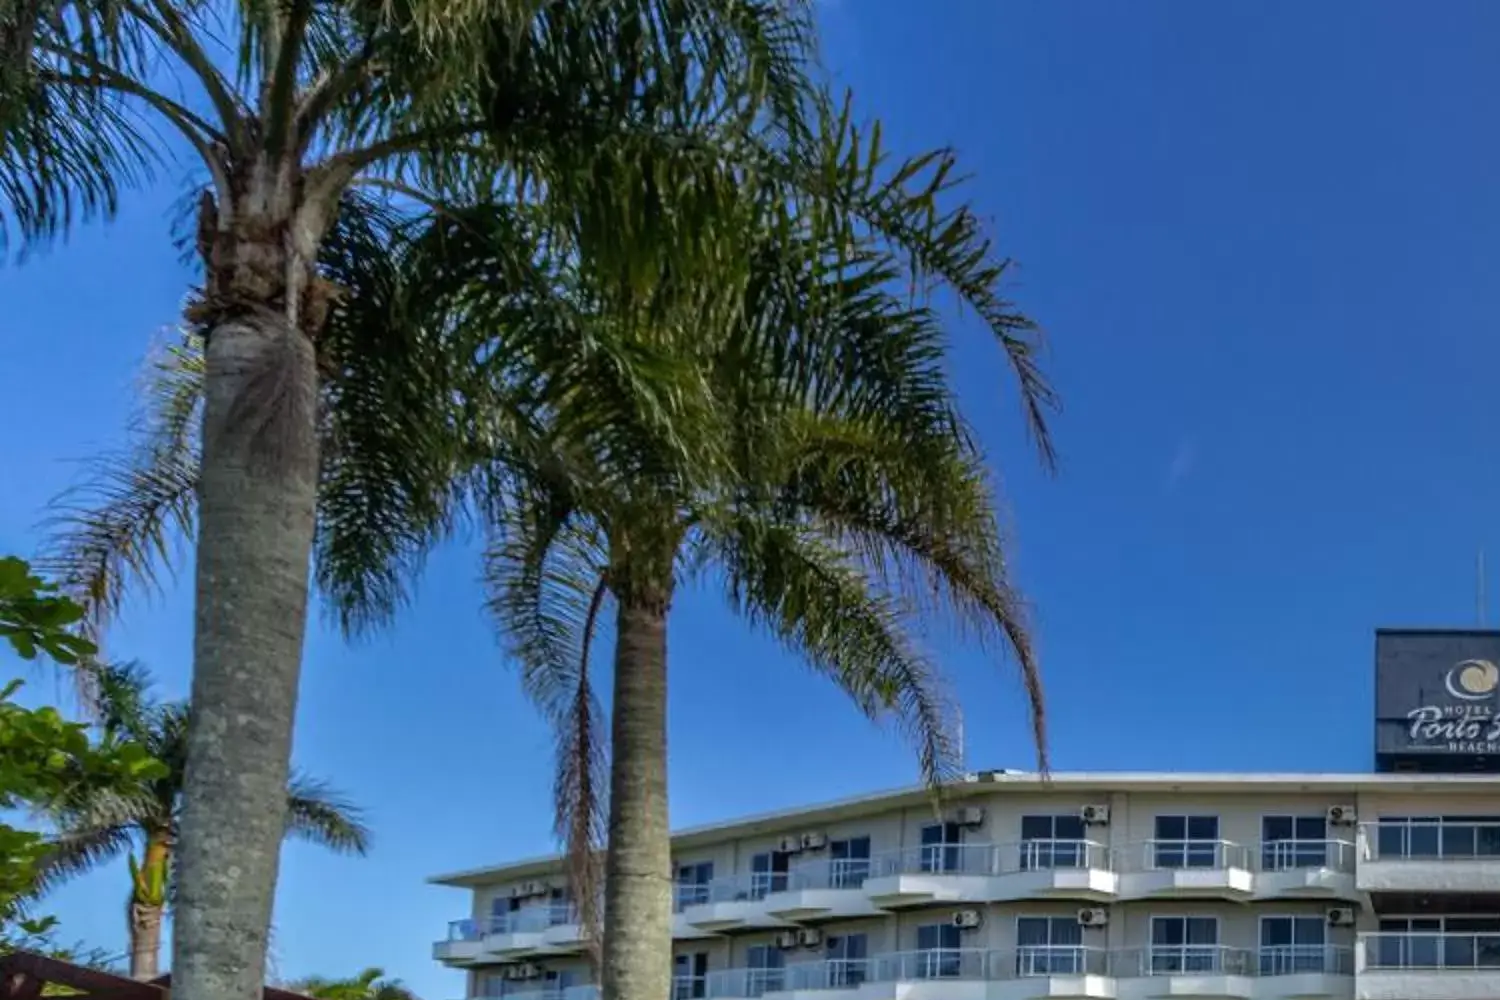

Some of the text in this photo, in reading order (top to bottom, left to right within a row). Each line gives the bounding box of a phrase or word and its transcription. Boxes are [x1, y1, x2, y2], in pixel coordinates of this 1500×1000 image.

[1444, 705, 1492, 715] HOTEL
[1407, 706, 1488, 739] Porto
[1449, 742, 1499, 752] BEACH
